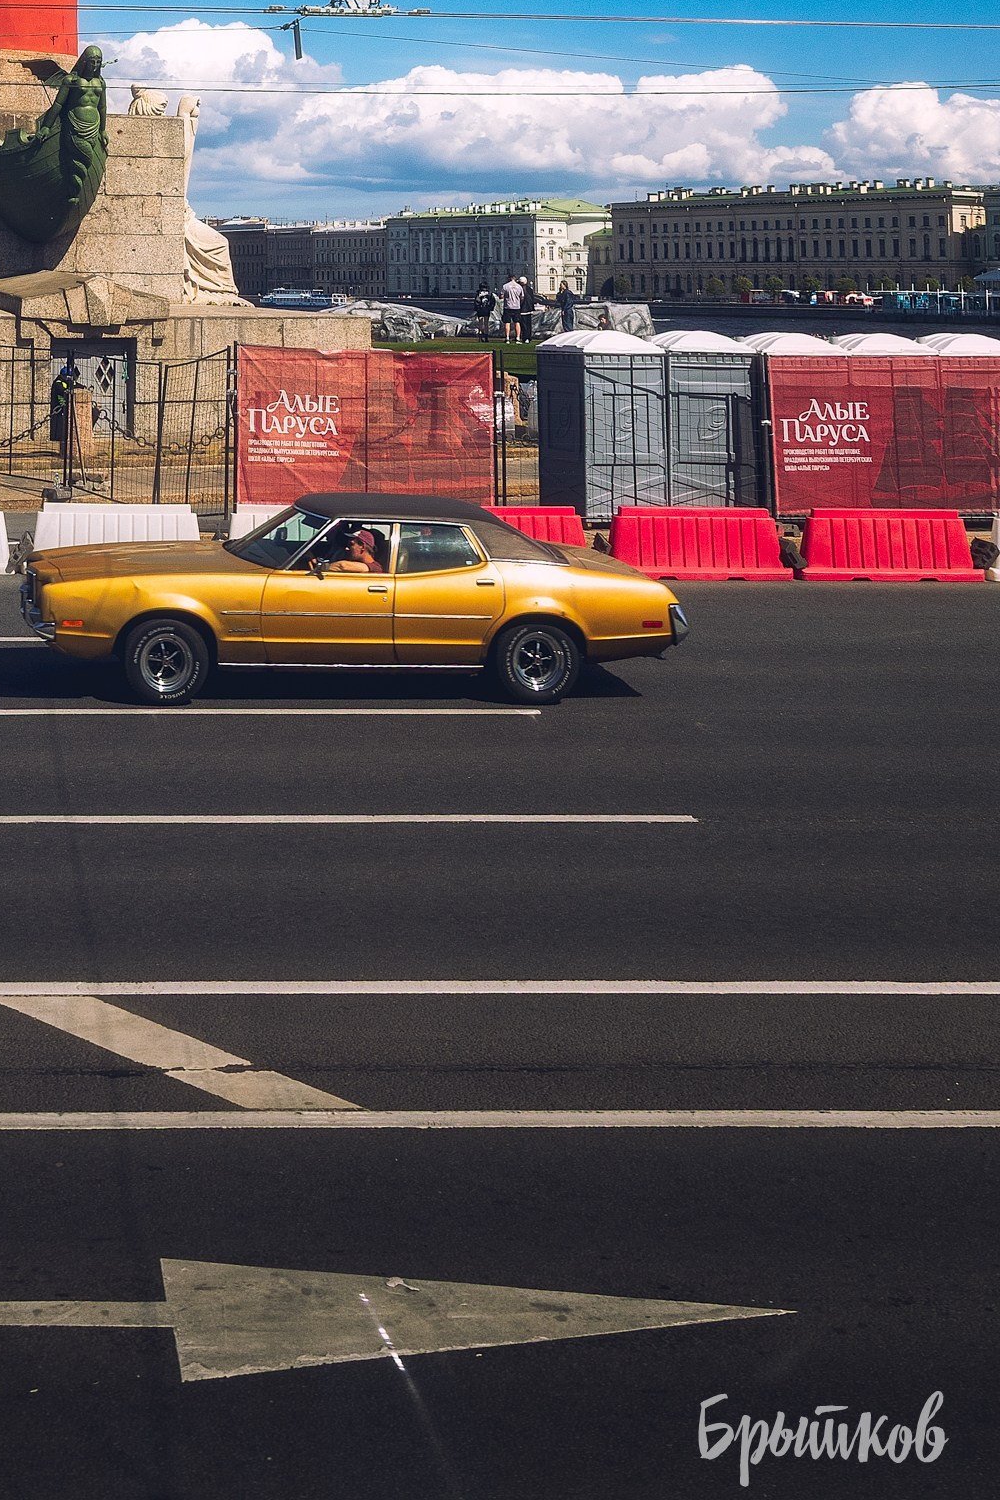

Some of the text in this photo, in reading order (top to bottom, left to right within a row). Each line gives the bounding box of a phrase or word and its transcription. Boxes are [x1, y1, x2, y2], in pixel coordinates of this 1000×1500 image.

[266, 389, 340, 413] АЛЫЕ
[798, 398, 870, 421] АЛЫЕ
[246, 408, 339, 438] ПАРУСА
[779, 418, 871, 446] ПАРУСА
[159, 689, 186, 700] MUSCLE
